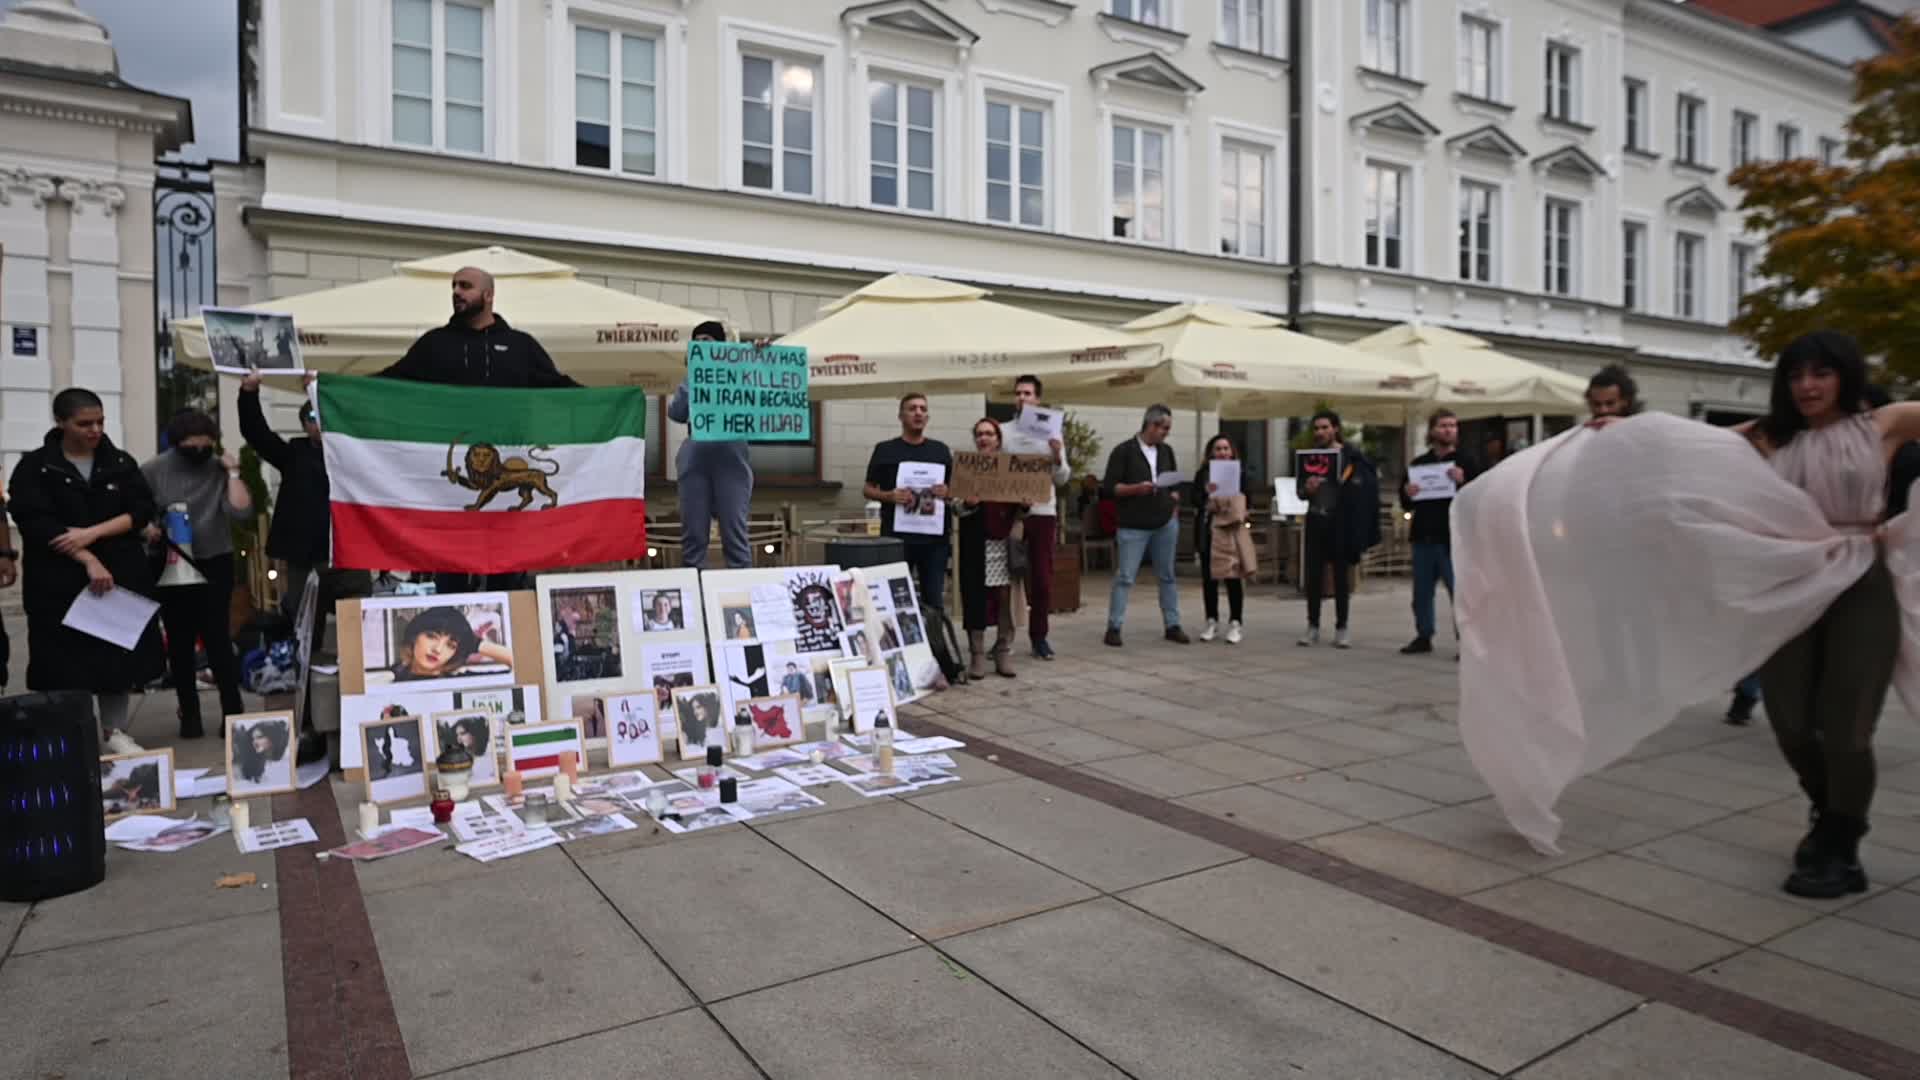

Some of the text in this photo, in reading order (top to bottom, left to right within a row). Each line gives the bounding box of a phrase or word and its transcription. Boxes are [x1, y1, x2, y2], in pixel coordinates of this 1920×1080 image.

[596, 329, 679, 344] ZWIERZYNIEC
[690, 344, 806, 367] A WOMAN HAS
[694, 368, 738, 385] BEEN
[742, 369, 802, 390] KILLED
[693, 387, 809, 409] IN IRAN BECAUSE
[694, 413, 803, 434] OF HER HIJAB
